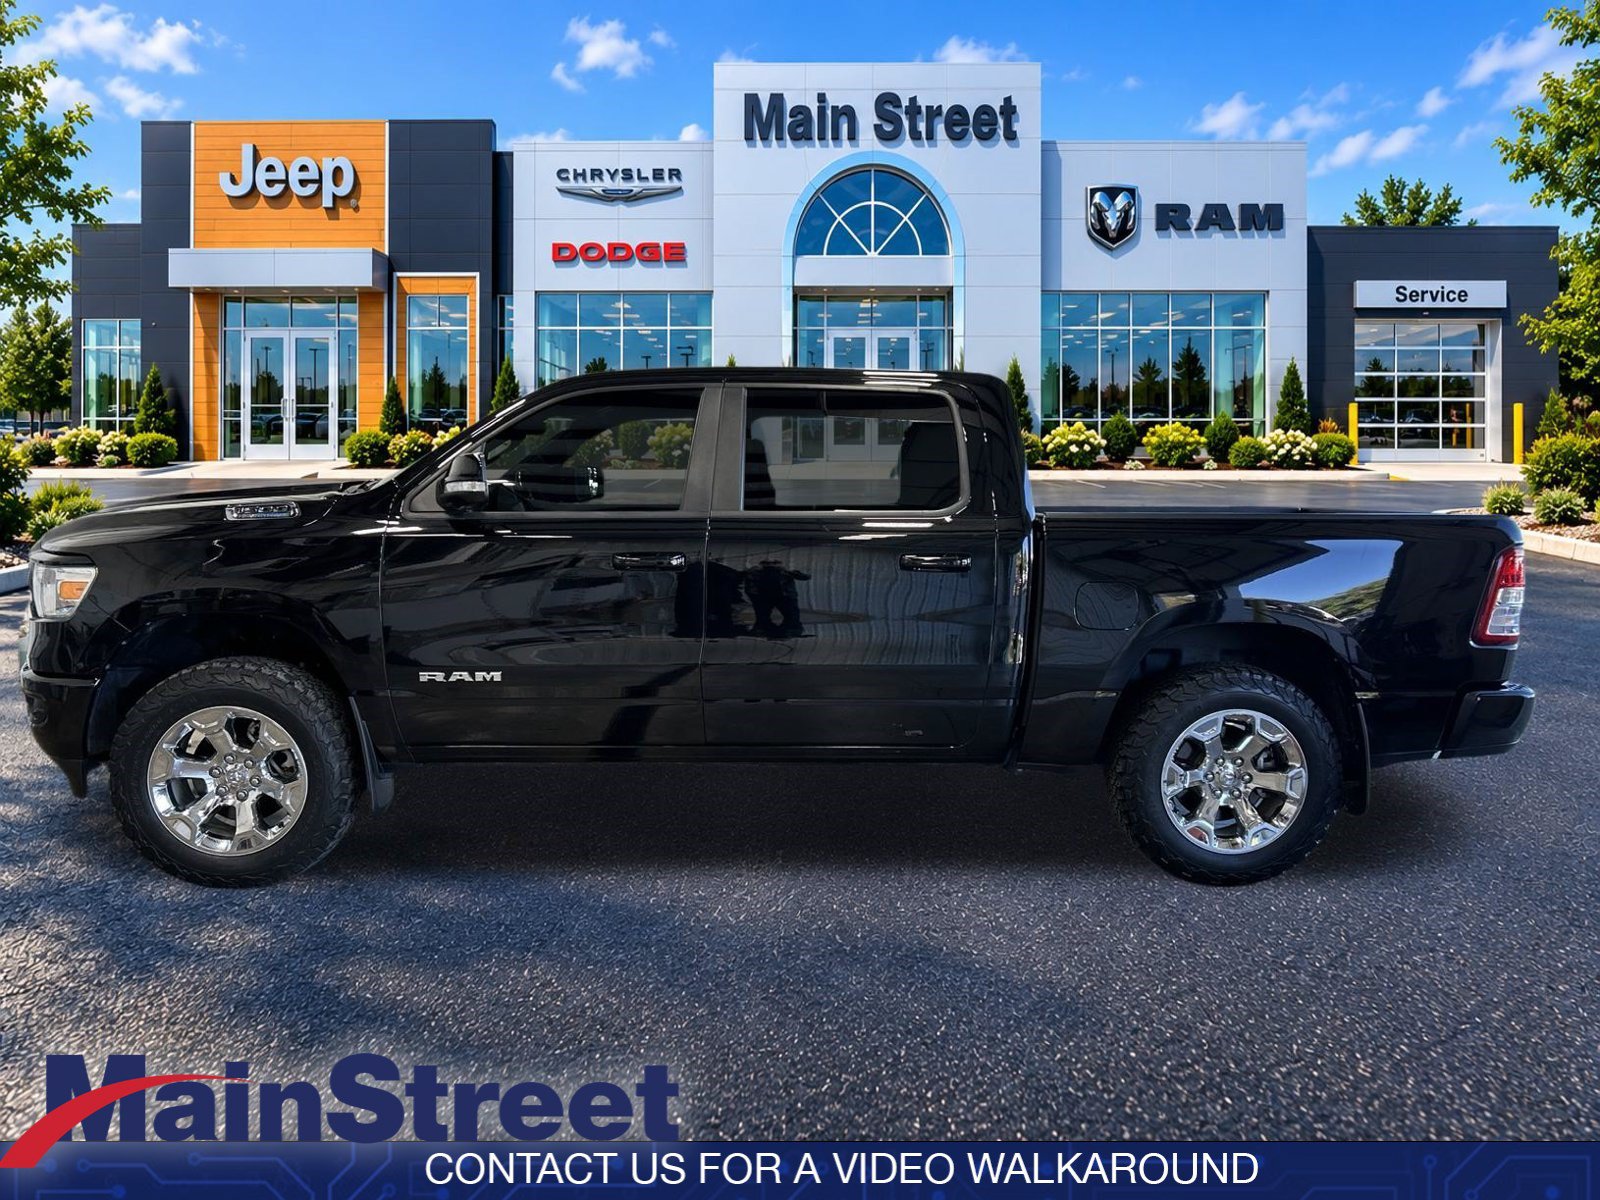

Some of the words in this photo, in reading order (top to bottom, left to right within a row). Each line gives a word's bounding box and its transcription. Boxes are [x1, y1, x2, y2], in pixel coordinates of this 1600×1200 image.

[744, 92, 857, 142] Main
[874, 92, 1018, 142] Street
[219, 143, 355, 209] Jeep
[556, 167, 682, 182] CHRYSLER
[1155, 203, 1284, 232] RAM
[551, 241, 687, 262] DODGE
[1394, 285, 1469, 304] Service
[418, 671, 502, 683] RAM
